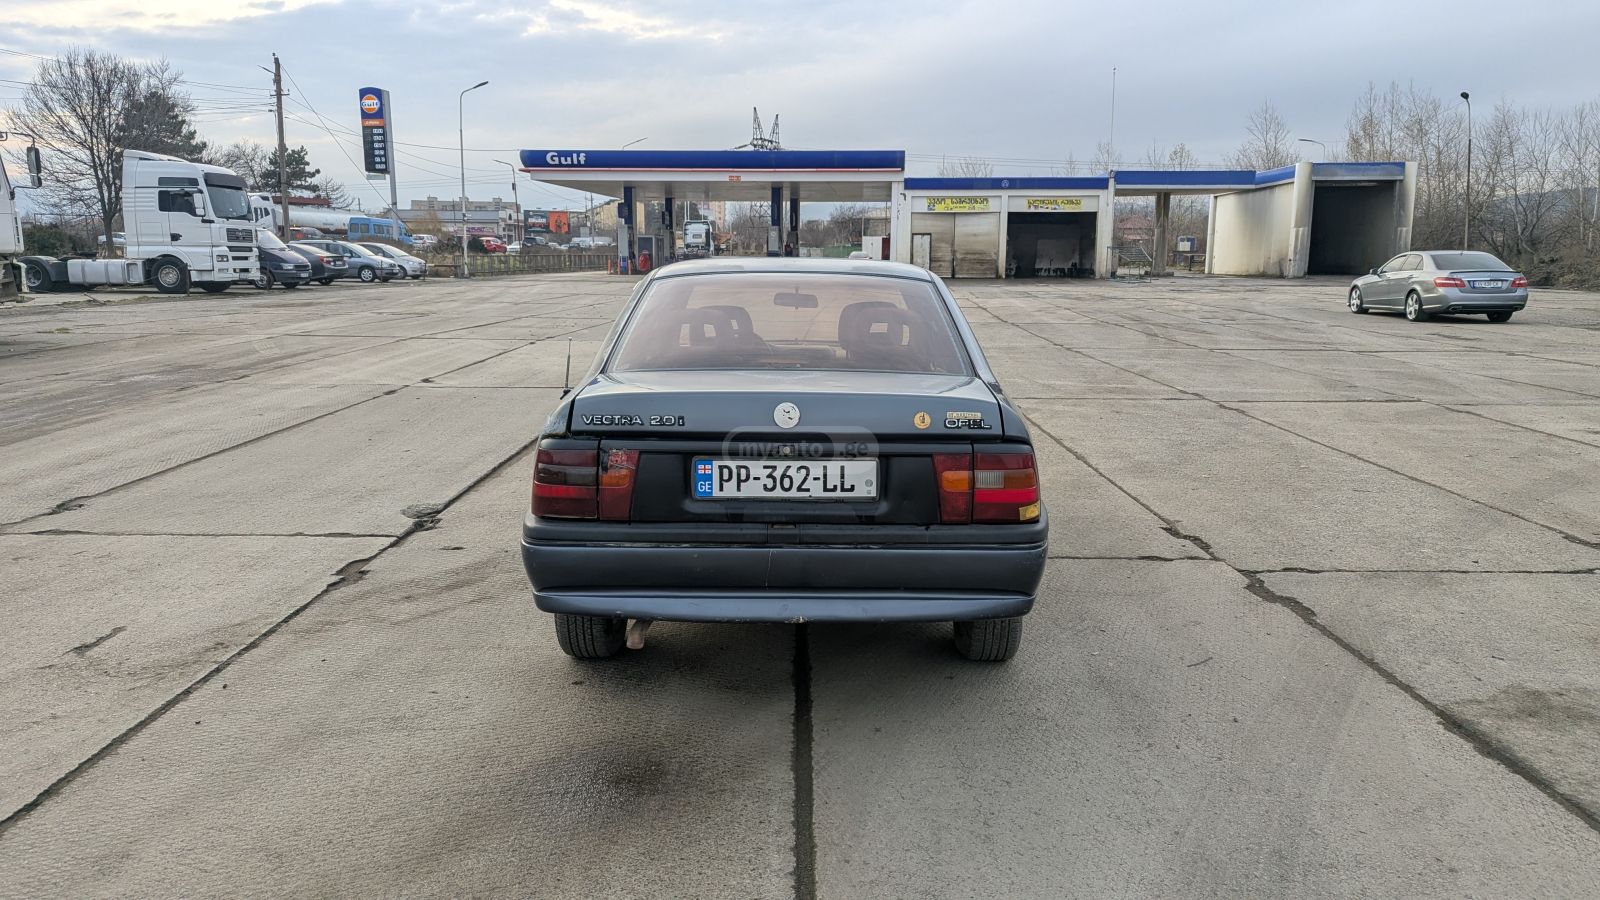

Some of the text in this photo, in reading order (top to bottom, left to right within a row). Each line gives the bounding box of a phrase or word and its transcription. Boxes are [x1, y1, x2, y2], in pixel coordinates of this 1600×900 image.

[545, 151, 587, 166] Gulf
[582, 414, 644, 426] VECTRA
[717, 464, 855, 493] PP-362-LL
[698, 481, 712, 492] GE
